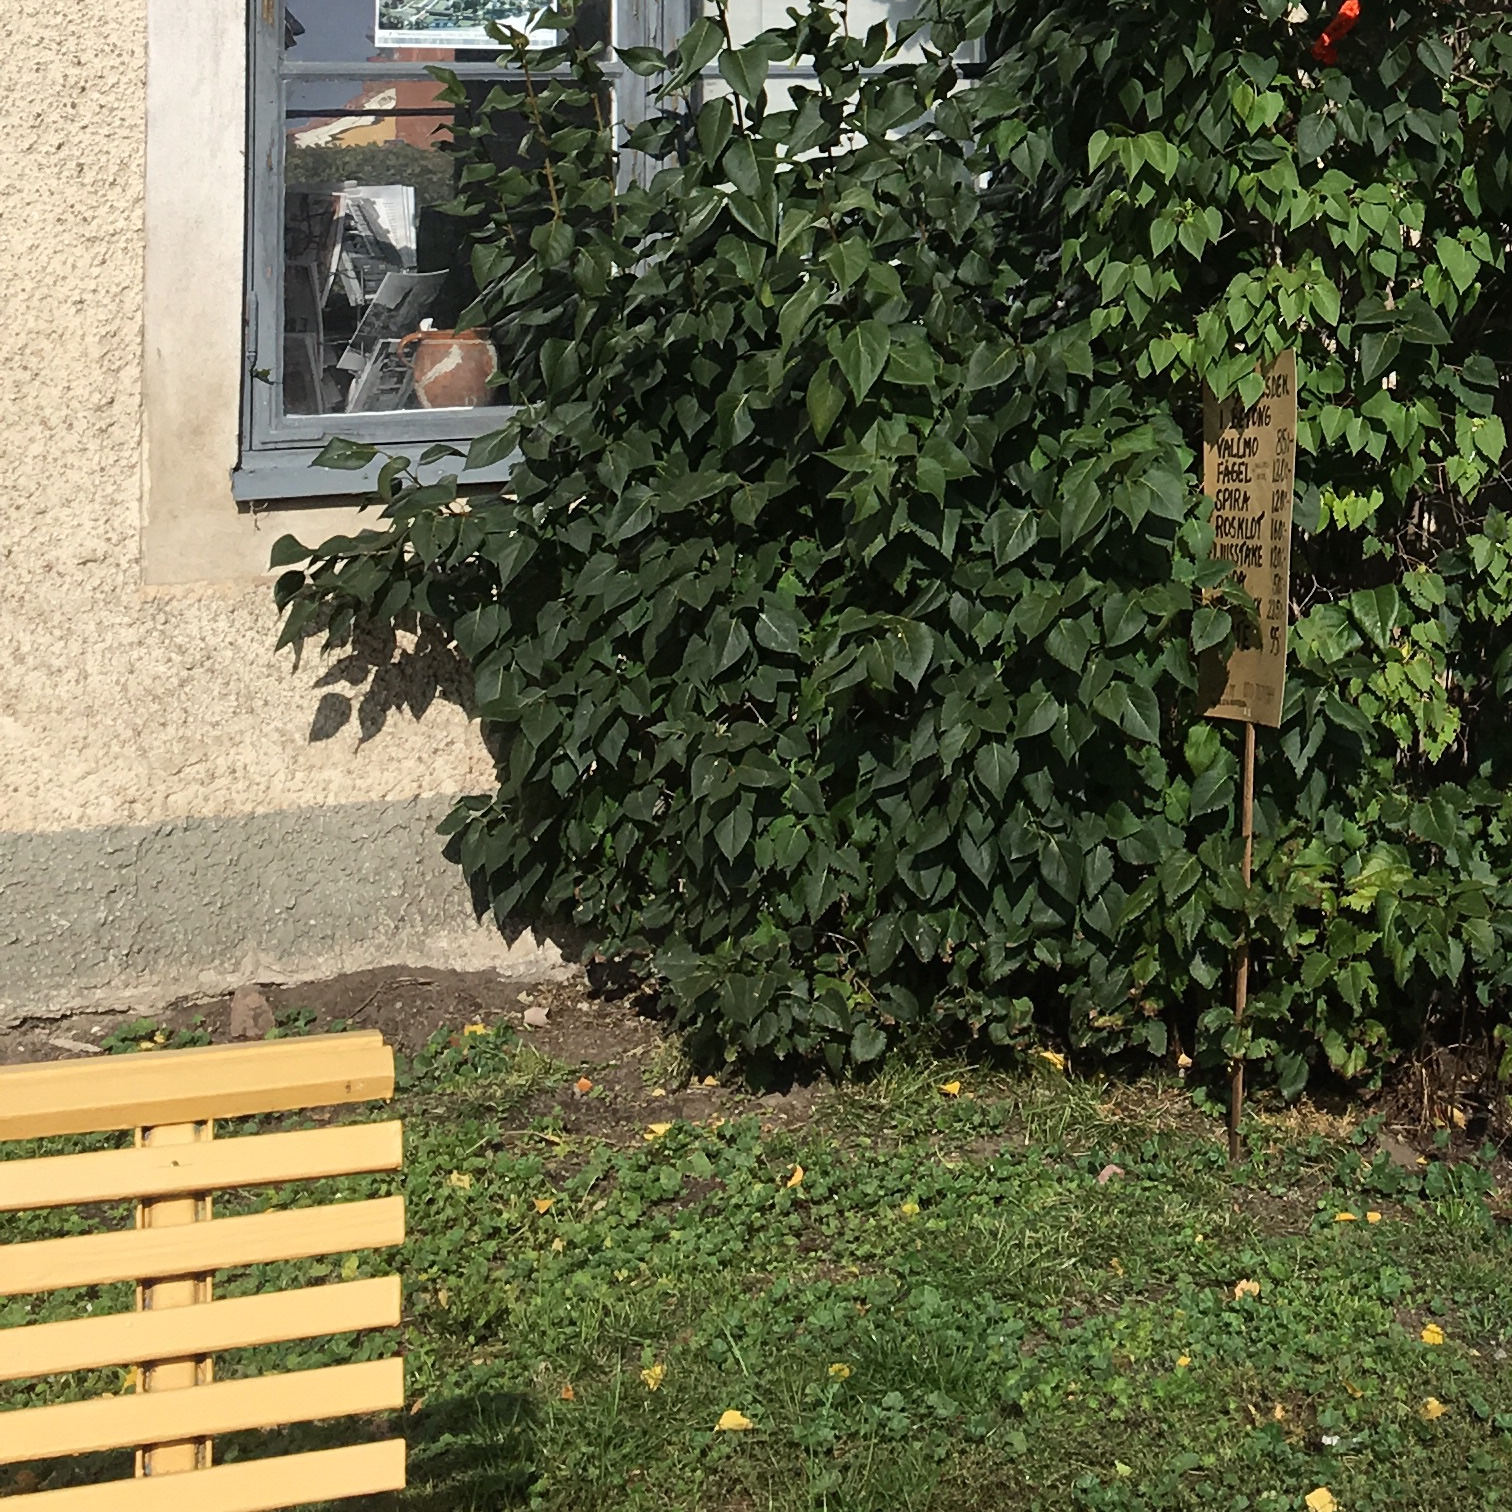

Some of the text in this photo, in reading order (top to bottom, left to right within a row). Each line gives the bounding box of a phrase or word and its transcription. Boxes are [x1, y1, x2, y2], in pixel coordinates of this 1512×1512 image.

[1217, 436, 1259, 459] VALLMO
[1216, 459, 1252, 485] FÅGEL
[1214, 487, 1251, 512] SPIRA
[1215, 510, 1266, 540] ROSKLOT
